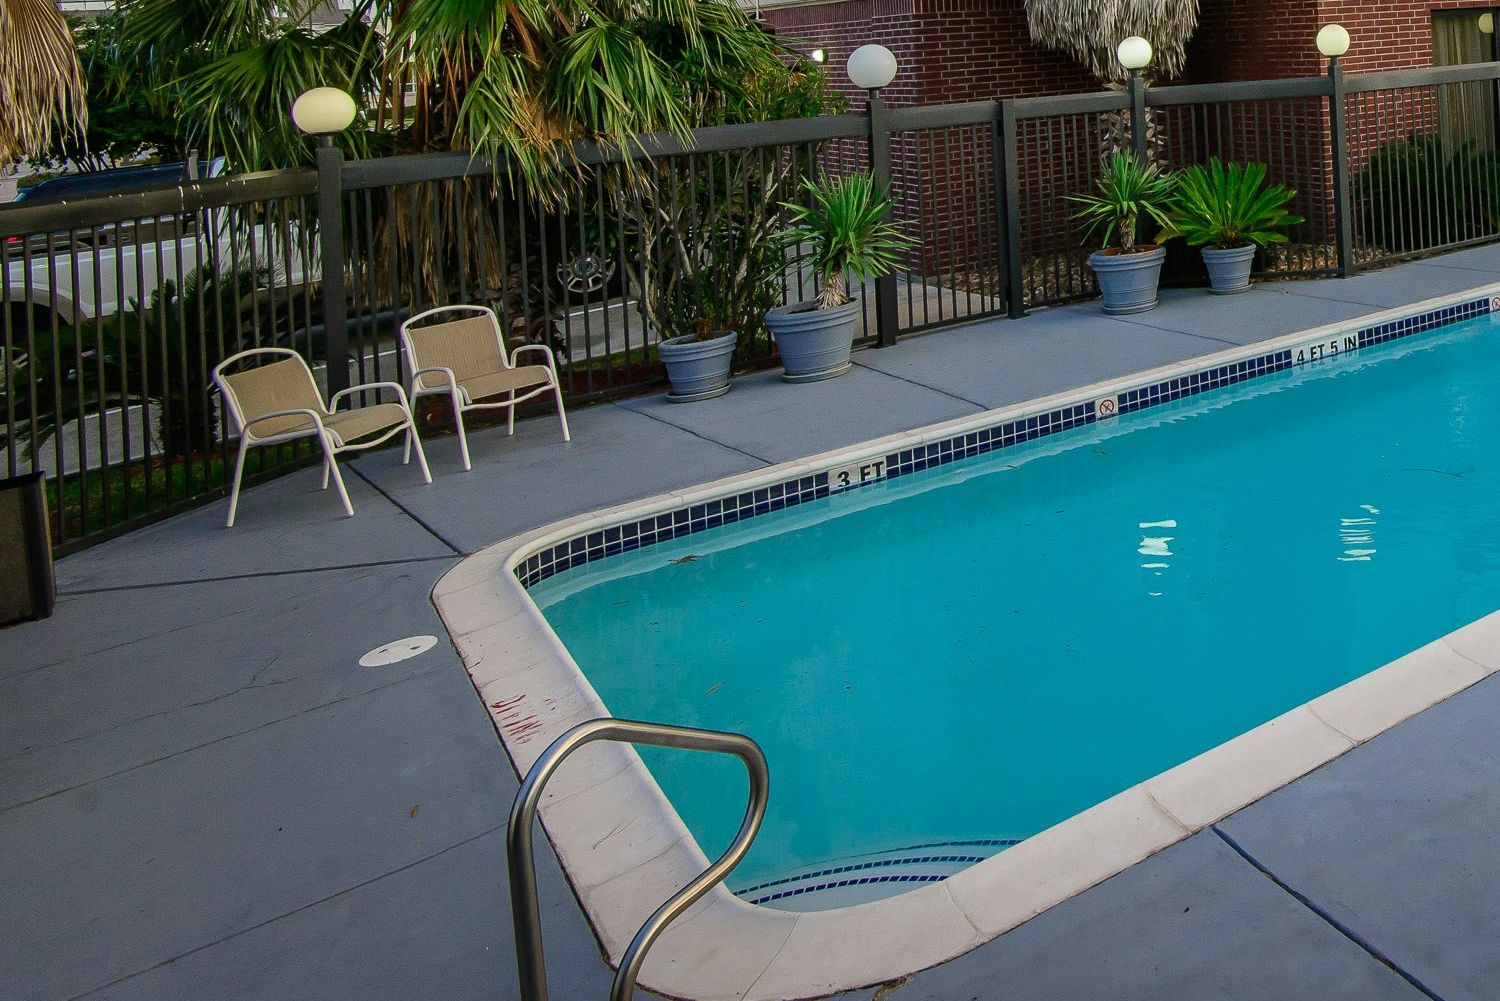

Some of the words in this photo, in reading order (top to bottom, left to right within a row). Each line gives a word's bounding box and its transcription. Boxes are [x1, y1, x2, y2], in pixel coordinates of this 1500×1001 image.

[1296, 349, 1306, 363] 4
[1310, 343, 1325, 359] FT
[1330, 340, 1339, 354] 5
[1344, 335, 1357, 352] IN
[837, 470, 851, 487] 3
[859, 460, 885, 483] FT
